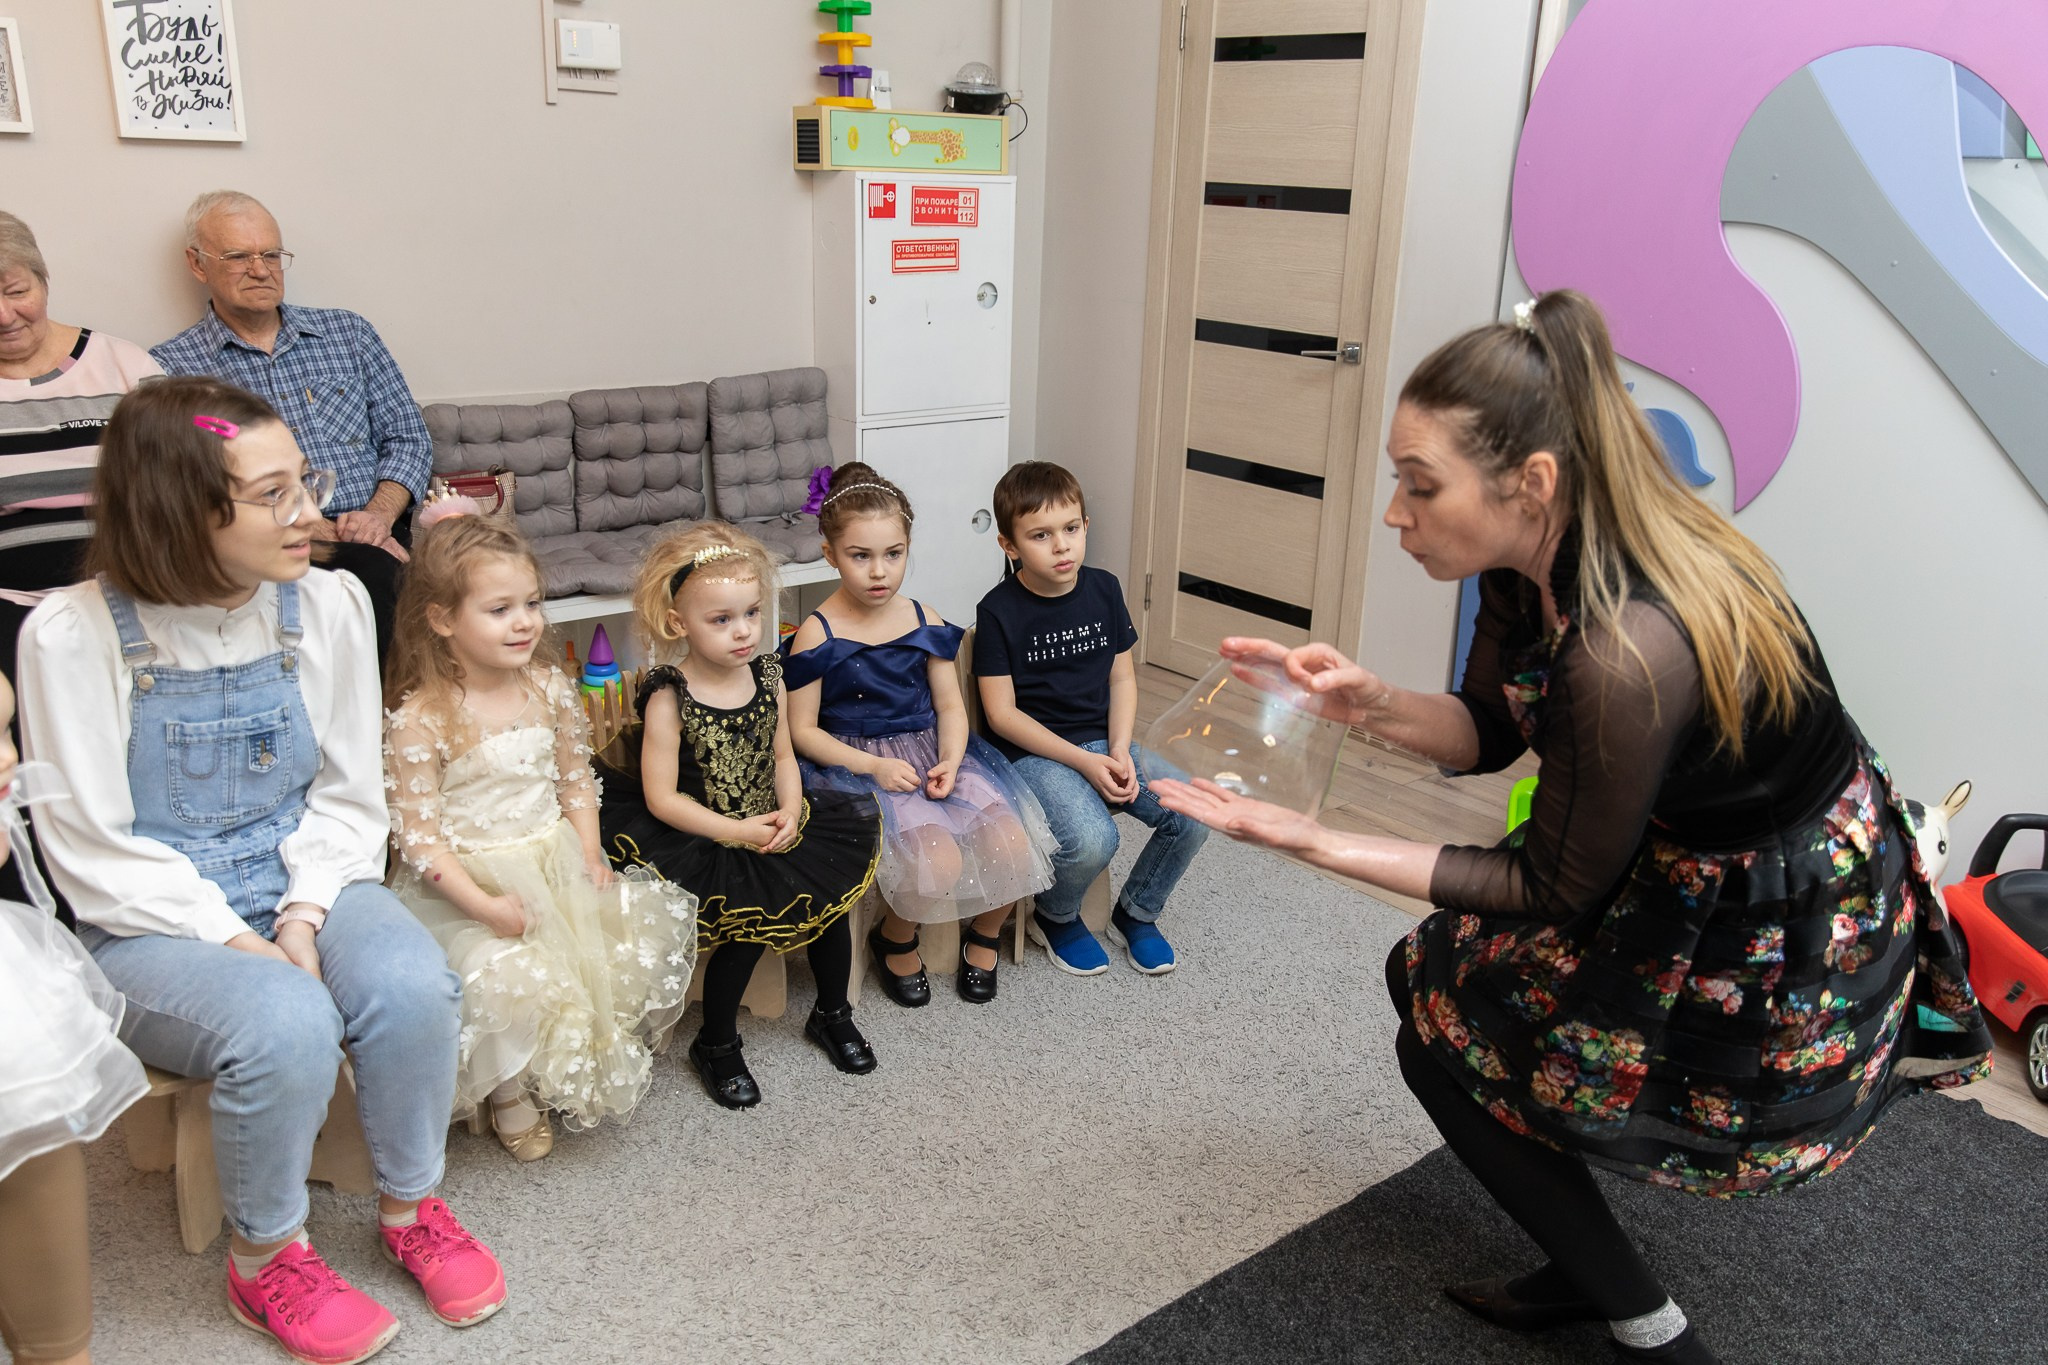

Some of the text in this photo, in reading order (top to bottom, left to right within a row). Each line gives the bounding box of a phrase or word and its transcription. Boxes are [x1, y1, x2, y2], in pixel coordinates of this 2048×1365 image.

[915, 197, 958, 206] ПРИ ПОЖАРЕ
[962, 196, 972, 205] 01
[915, 206, 958, 215] ЗВОНИТЬ
[959, 212, 974, 221] 112
[896, 243, 955, 253] ОТВЕТСТВЕННЫЙ
[1030, 622, 1102, 646] TOMMY
[1027, 636, 1108, 662] HILFIGER
